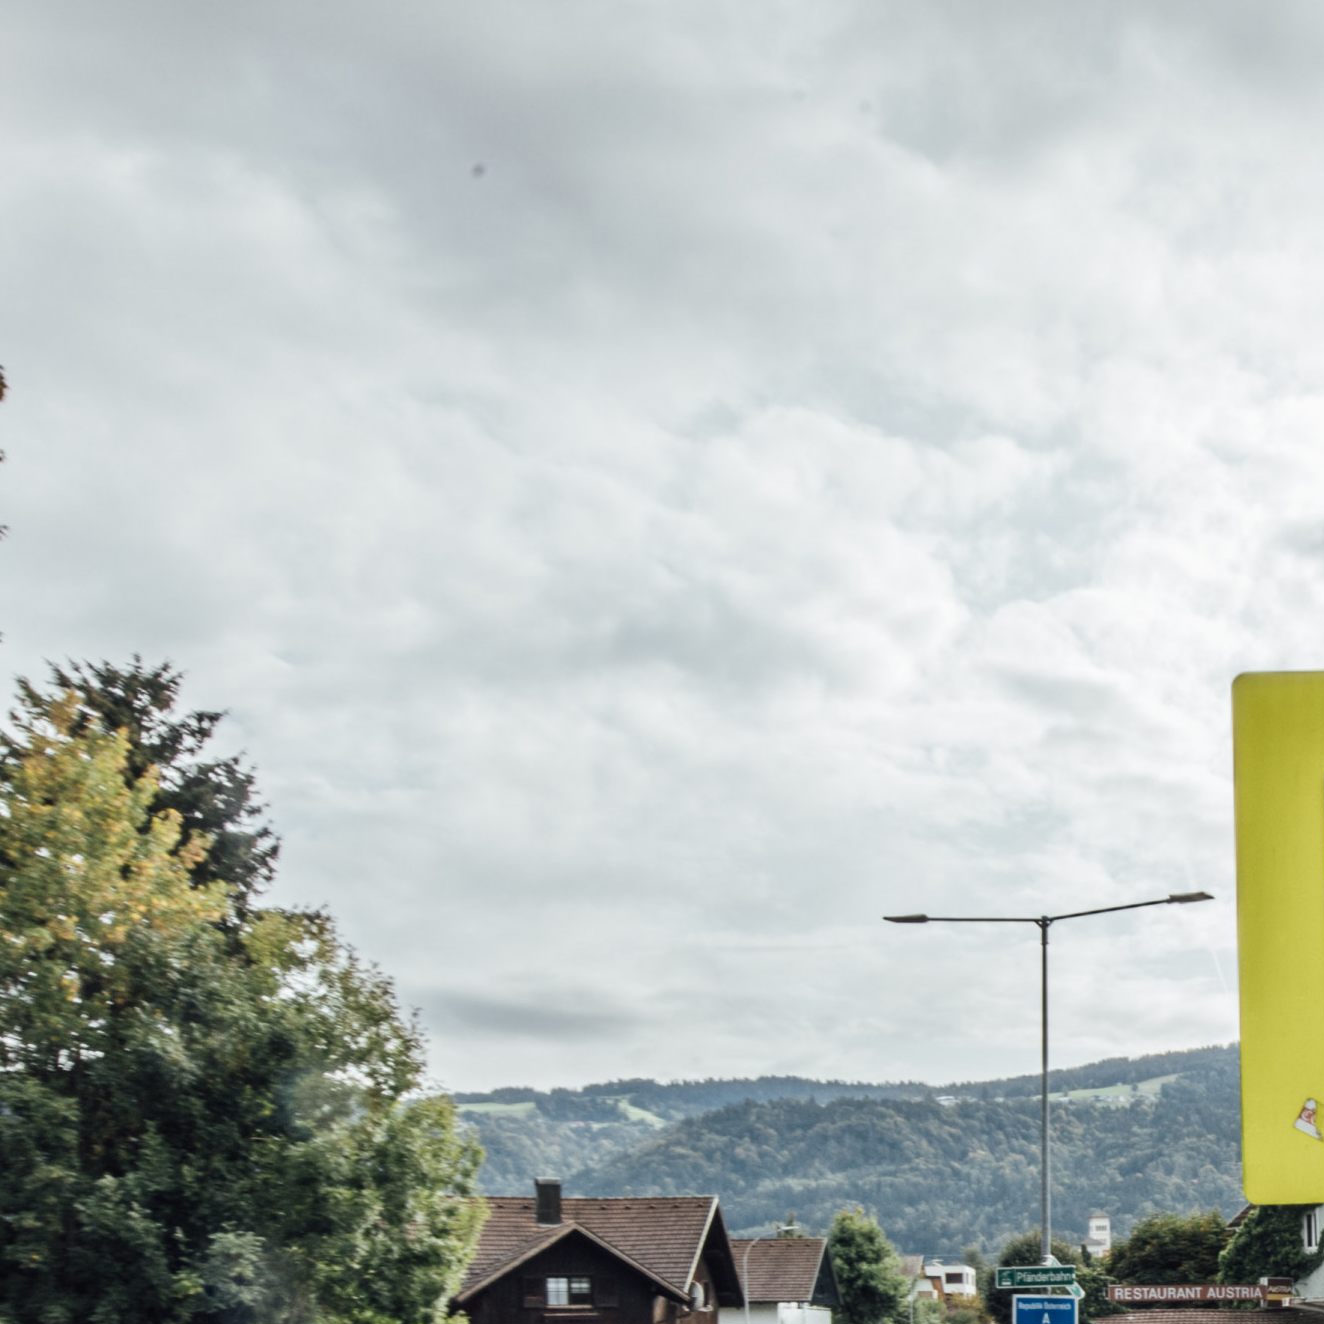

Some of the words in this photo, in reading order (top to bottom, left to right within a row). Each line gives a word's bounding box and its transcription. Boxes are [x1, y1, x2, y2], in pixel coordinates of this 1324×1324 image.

[1114, 1287, 1202, 1300] RESTAURANT
[1207, 1286, 1262, 1299] AUSTRIA
[1042, 1312, 1050, 1324] A
